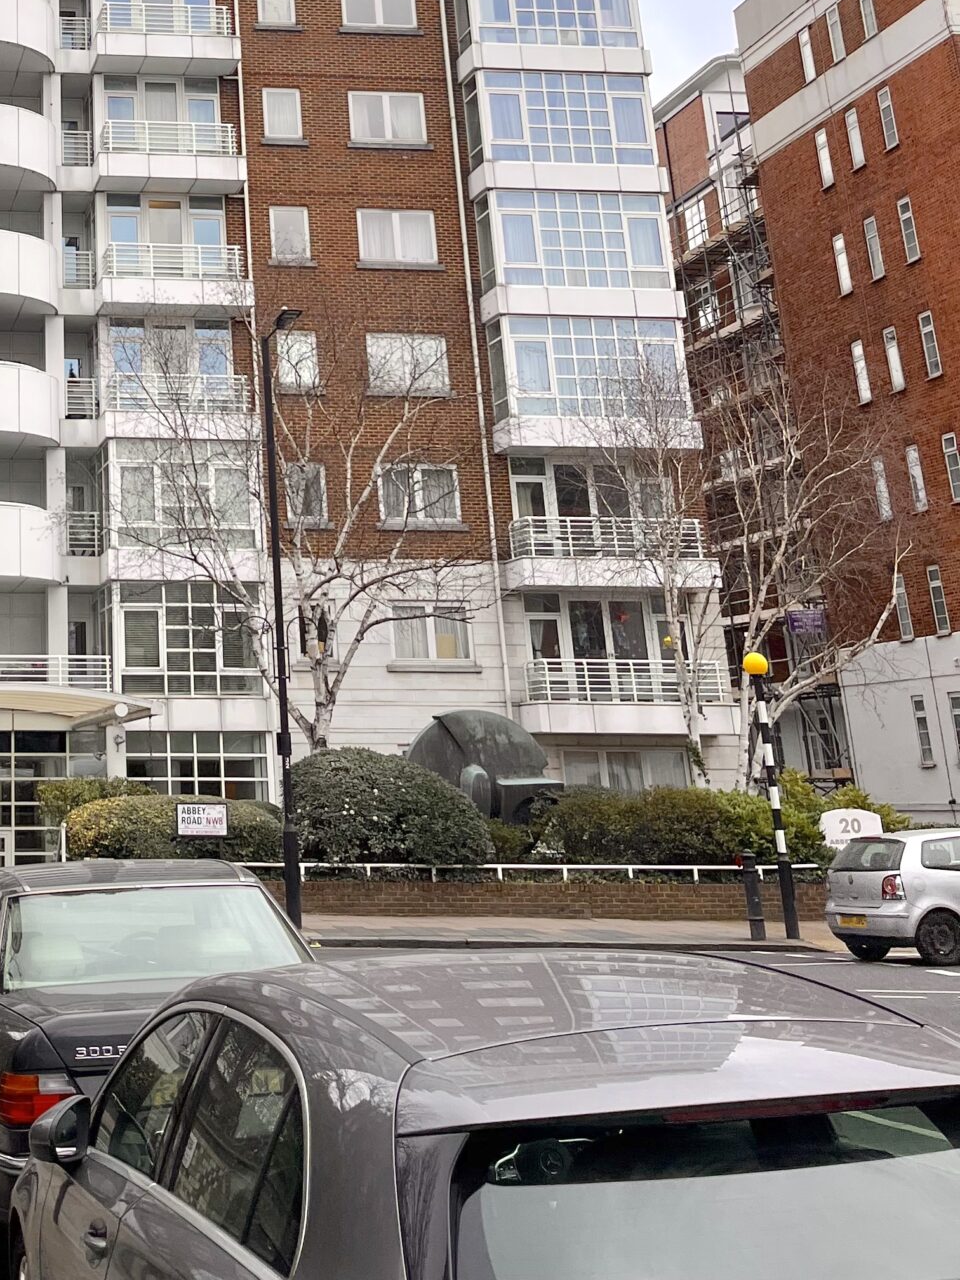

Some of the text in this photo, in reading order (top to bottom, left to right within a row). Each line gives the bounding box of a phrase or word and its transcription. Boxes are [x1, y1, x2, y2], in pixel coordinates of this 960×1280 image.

[181, 806, 207, 815] ABBEY
[181, 816, 202, 825] ROAD
[838, 817, 862, 834] 20
[75, 1046, 113, 1057] 300
